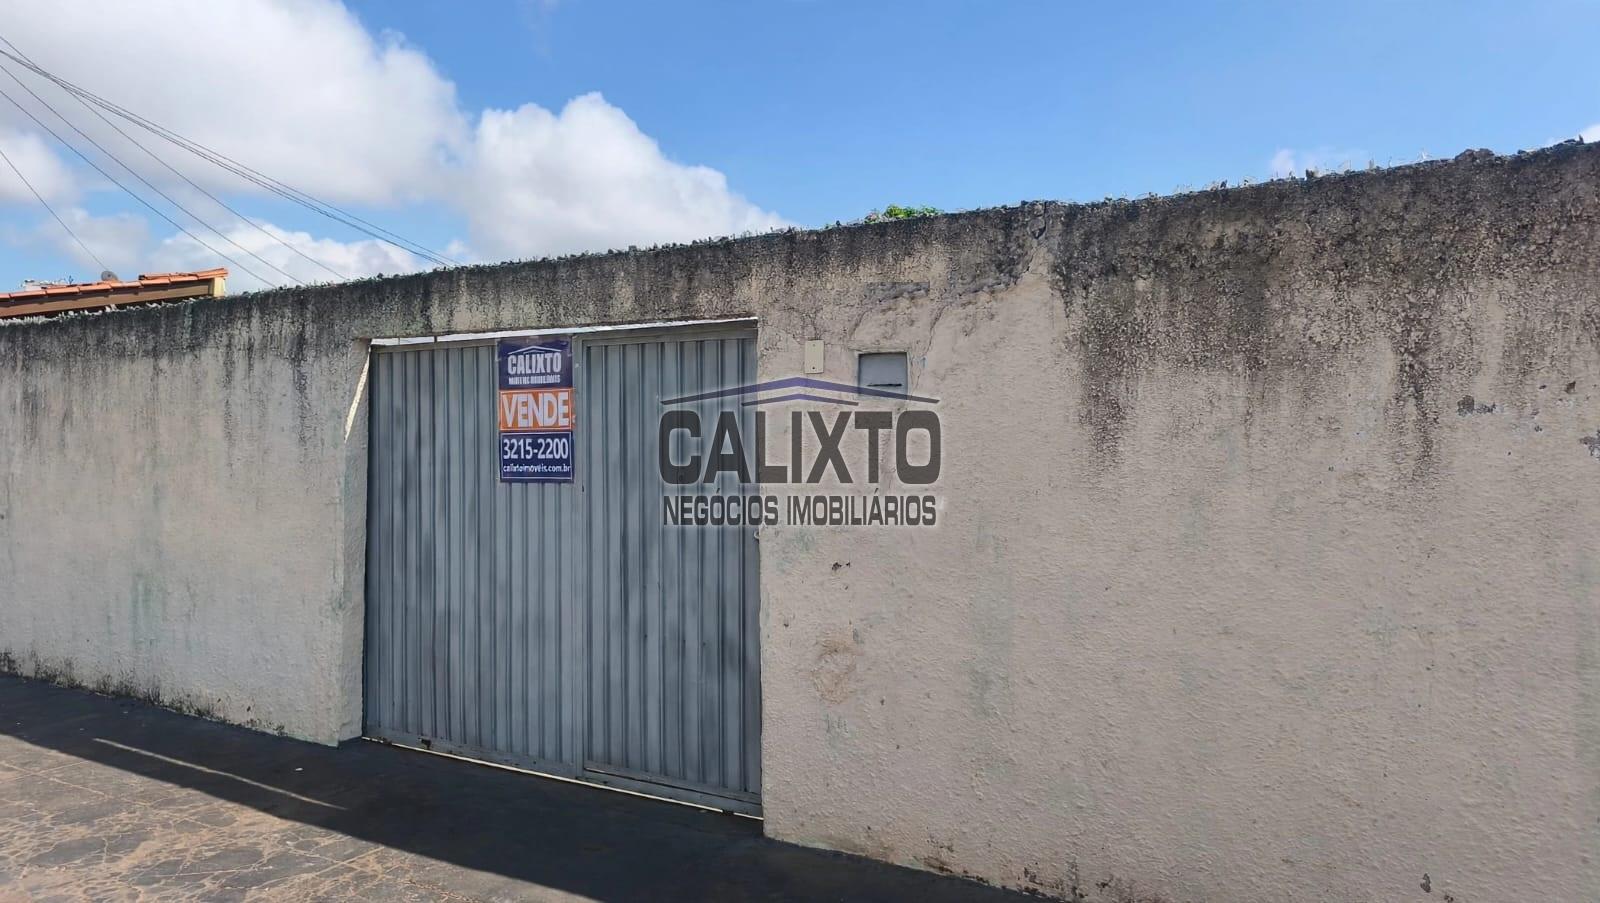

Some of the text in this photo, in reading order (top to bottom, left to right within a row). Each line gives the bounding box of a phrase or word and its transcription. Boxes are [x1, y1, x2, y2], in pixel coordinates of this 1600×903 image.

[507, 352, 562, 375] CALIXTO
[503, 392, 569, 427] VENDE
[503, 438, 569, 460] 3215-2200
